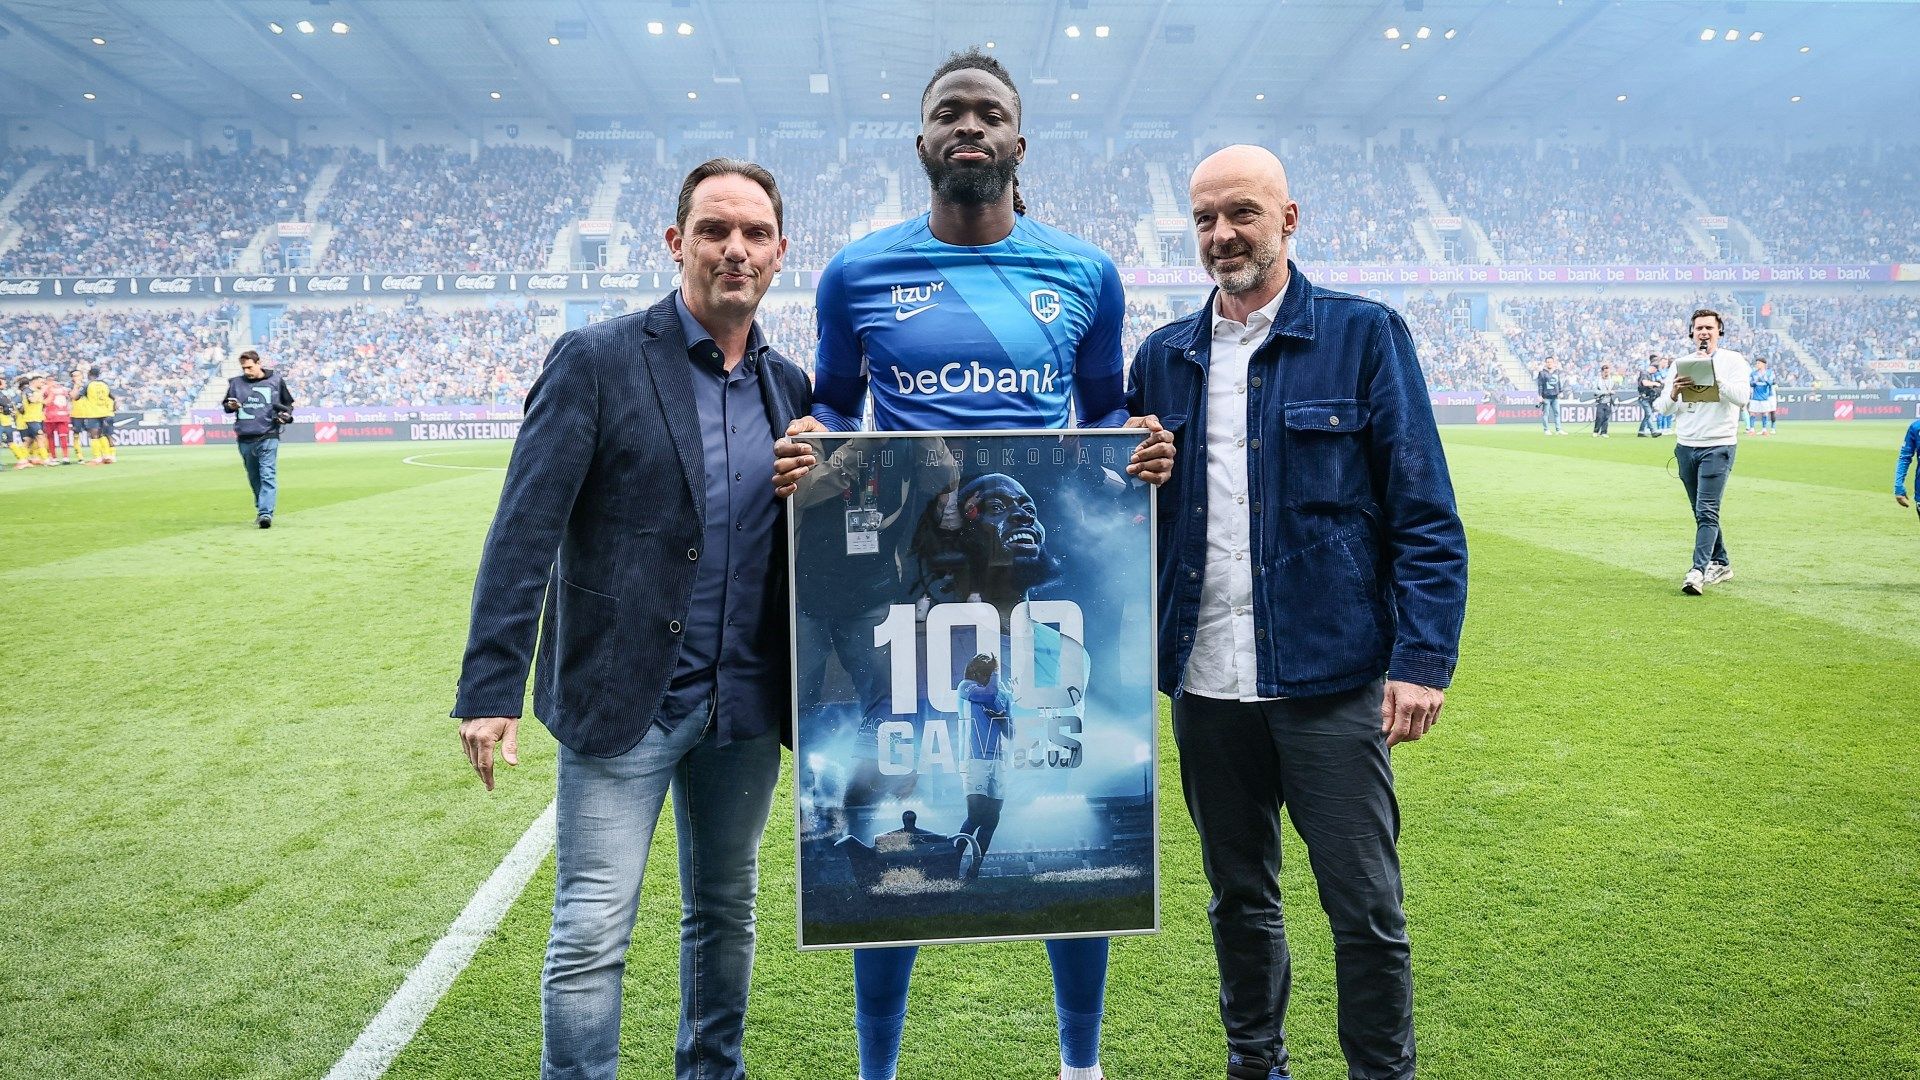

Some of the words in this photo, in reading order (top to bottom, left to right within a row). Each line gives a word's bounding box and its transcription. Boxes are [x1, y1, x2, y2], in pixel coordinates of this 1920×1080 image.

[1125, 129, 1179, 139] sterker
[1147, 268, 1182, 283] bank
[1189, 268, 1206, 282] be
[1330, 269, 1348, 282] be
[1360, 268, 1394, 282] bank
[1400, 268, 1418, 282] be
[1429, 268, 1464, 282] bank
[1469, 268, 1487, 281] be
[1499, 268, 1533, 281] bank
[1538, 268, 1556, 280] be
[1567, 268, 1601, 280] bank
[1607, 267, 1624, 280] be
[1635, 267, 1669, 280] bank
[1675, 267, 1692, 280] be
[1703, 267, 1736, 280] bank
[1742, 267, 1760, 280] be
[1770, 267, 1804, 280] bank
[1809, 267, 1826, 280] be
[1837, 267, 1870, 280] bank
[890, 284, 930, 304] itzu
[1560, 406, 1577, 422] DE
[1855, 406, 1902, 414] NELISSEN
[339, 427, 394, 436] NELISSEN
[410, 424, 428, 441] DE
[429, 423, 500, 440] BAKSTEEN
[873, 600, 1083, 714] 100
